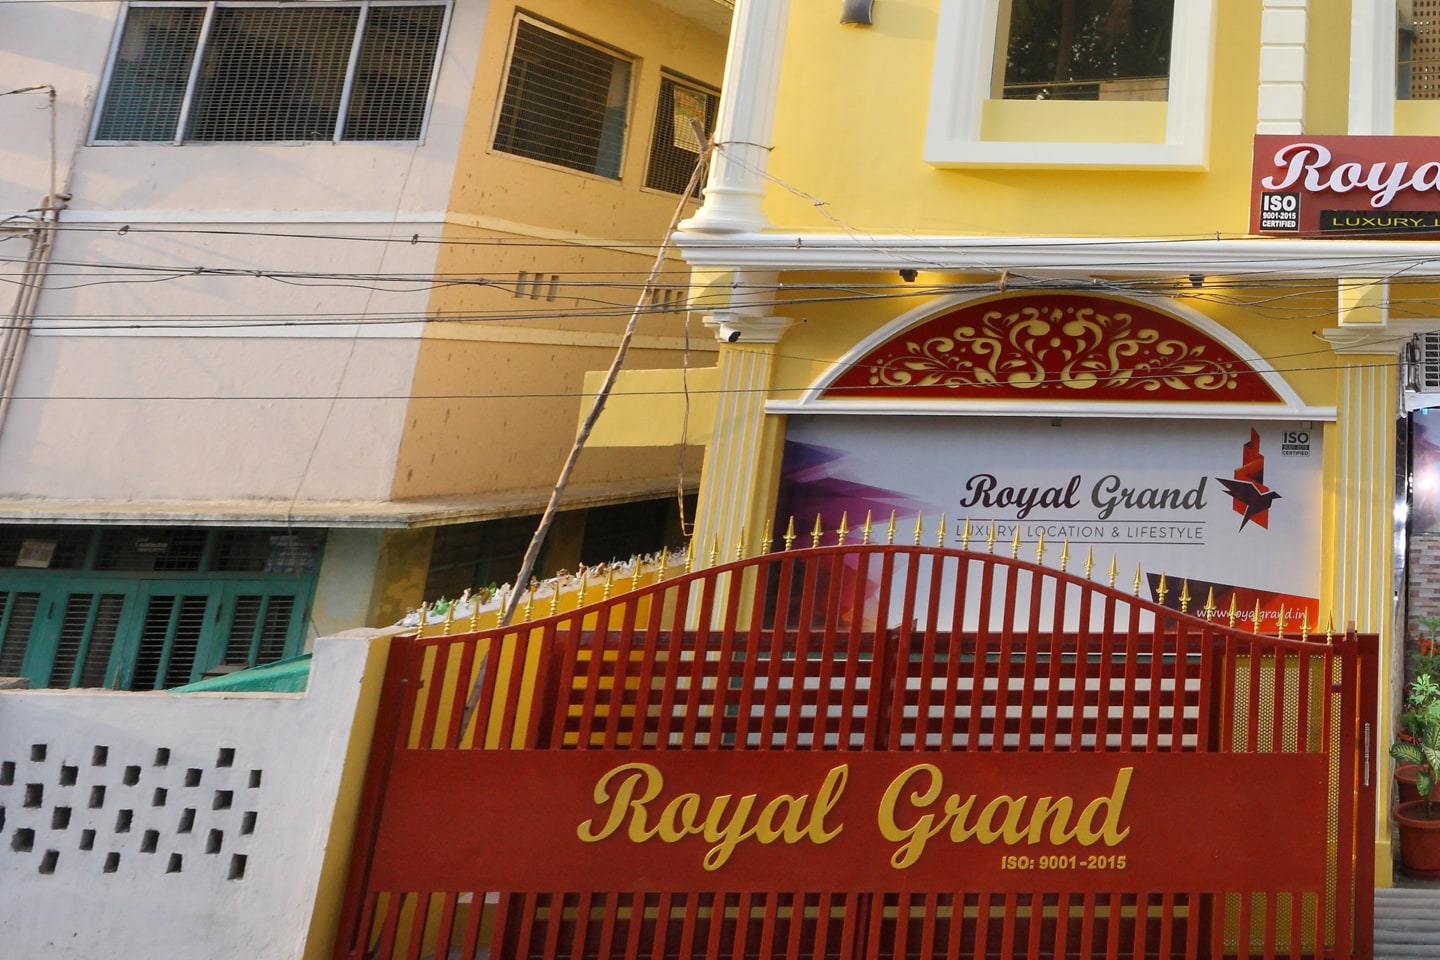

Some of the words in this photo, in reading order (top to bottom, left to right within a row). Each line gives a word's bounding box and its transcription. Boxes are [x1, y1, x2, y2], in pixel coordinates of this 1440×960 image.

[1263, 195, 1297, 211] ISO
[1262, 211, 1297, 220] 9001-2015
[1262, 220, 1297, 228] CERTIFIED
[1283, 431, 1309, 444] ISO
[959, 473, 1082, 520] Royal
[1091, 474, 1208, 520] Grand
[1027, 526, 1104, 538] LOCATION
[1111, 527, 1121, 538] &
[1127, 527, 1203, 539] LIFESTYLE
[577, 762, 848, 871] Royal
[877, 762, 1134, 870] Grand
[1000, 855, 1035, 870] ISO:
